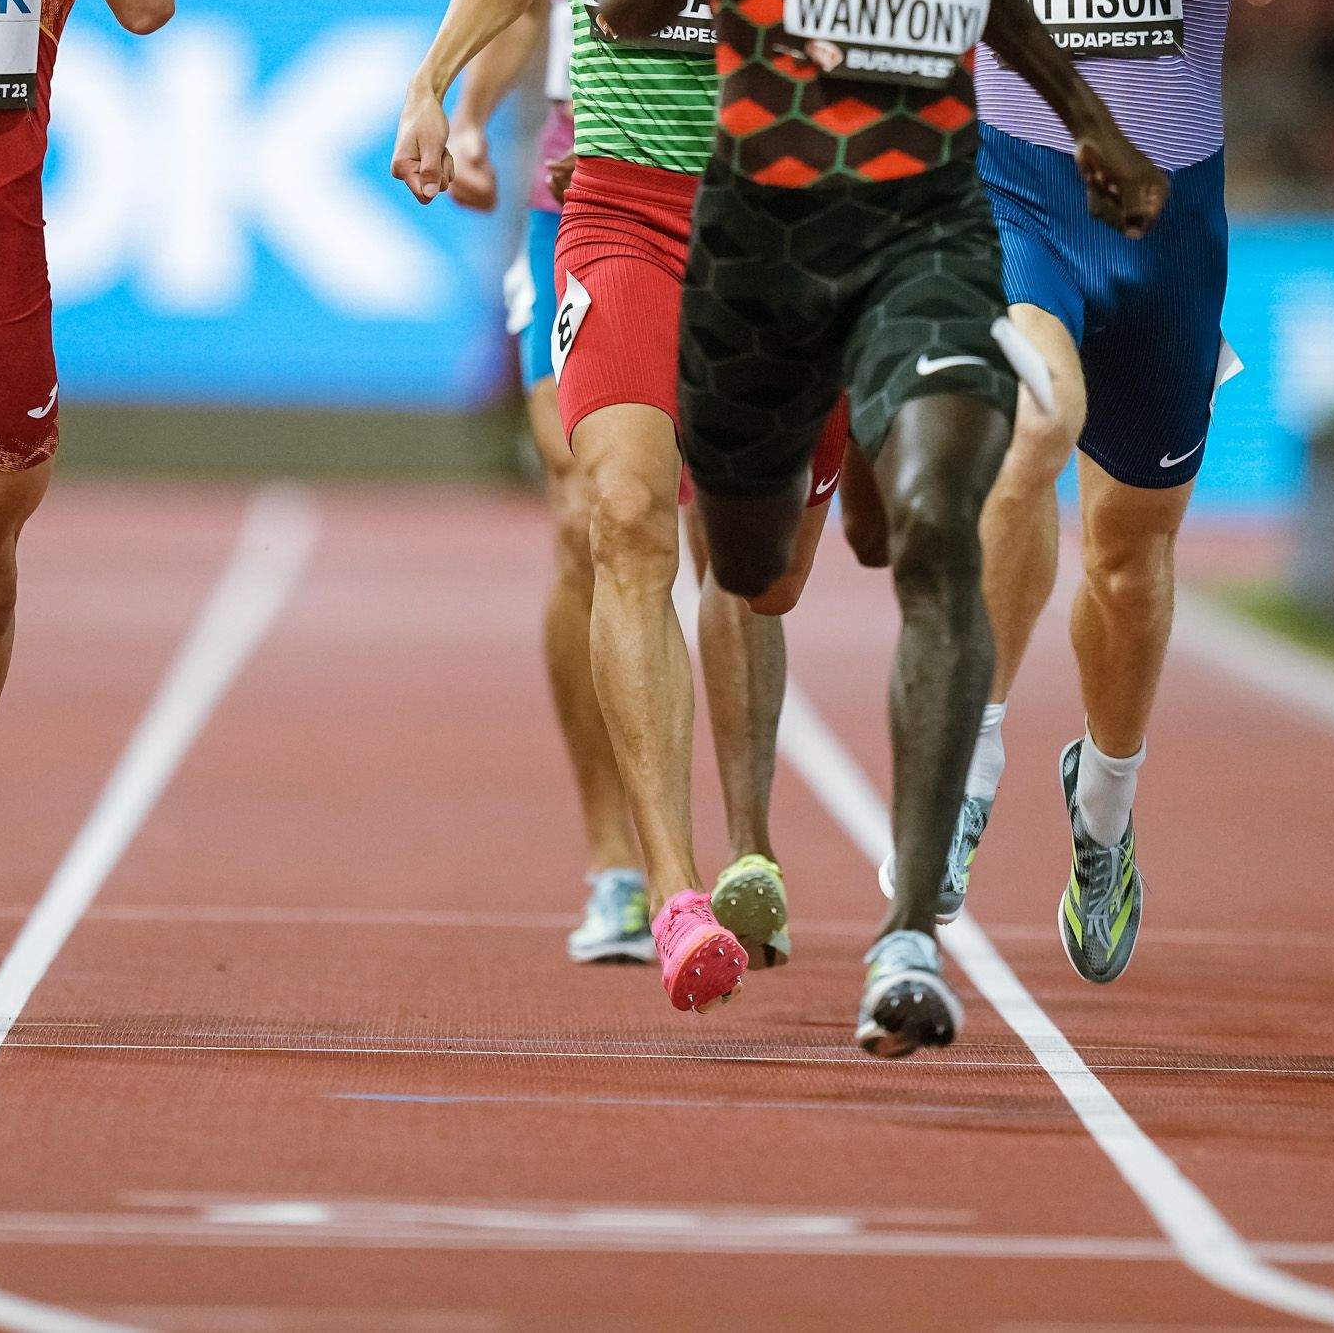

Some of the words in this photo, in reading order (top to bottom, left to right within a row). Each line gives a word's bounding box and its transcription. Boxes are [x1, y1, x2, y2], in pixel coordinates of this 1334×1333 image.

[651, 25, 718, 44] DAPES
[1053, 31, 1149, 50] UDAPEST
[1151, 29, 1174, 46] 23
[11, 82, 28, 99] 23
